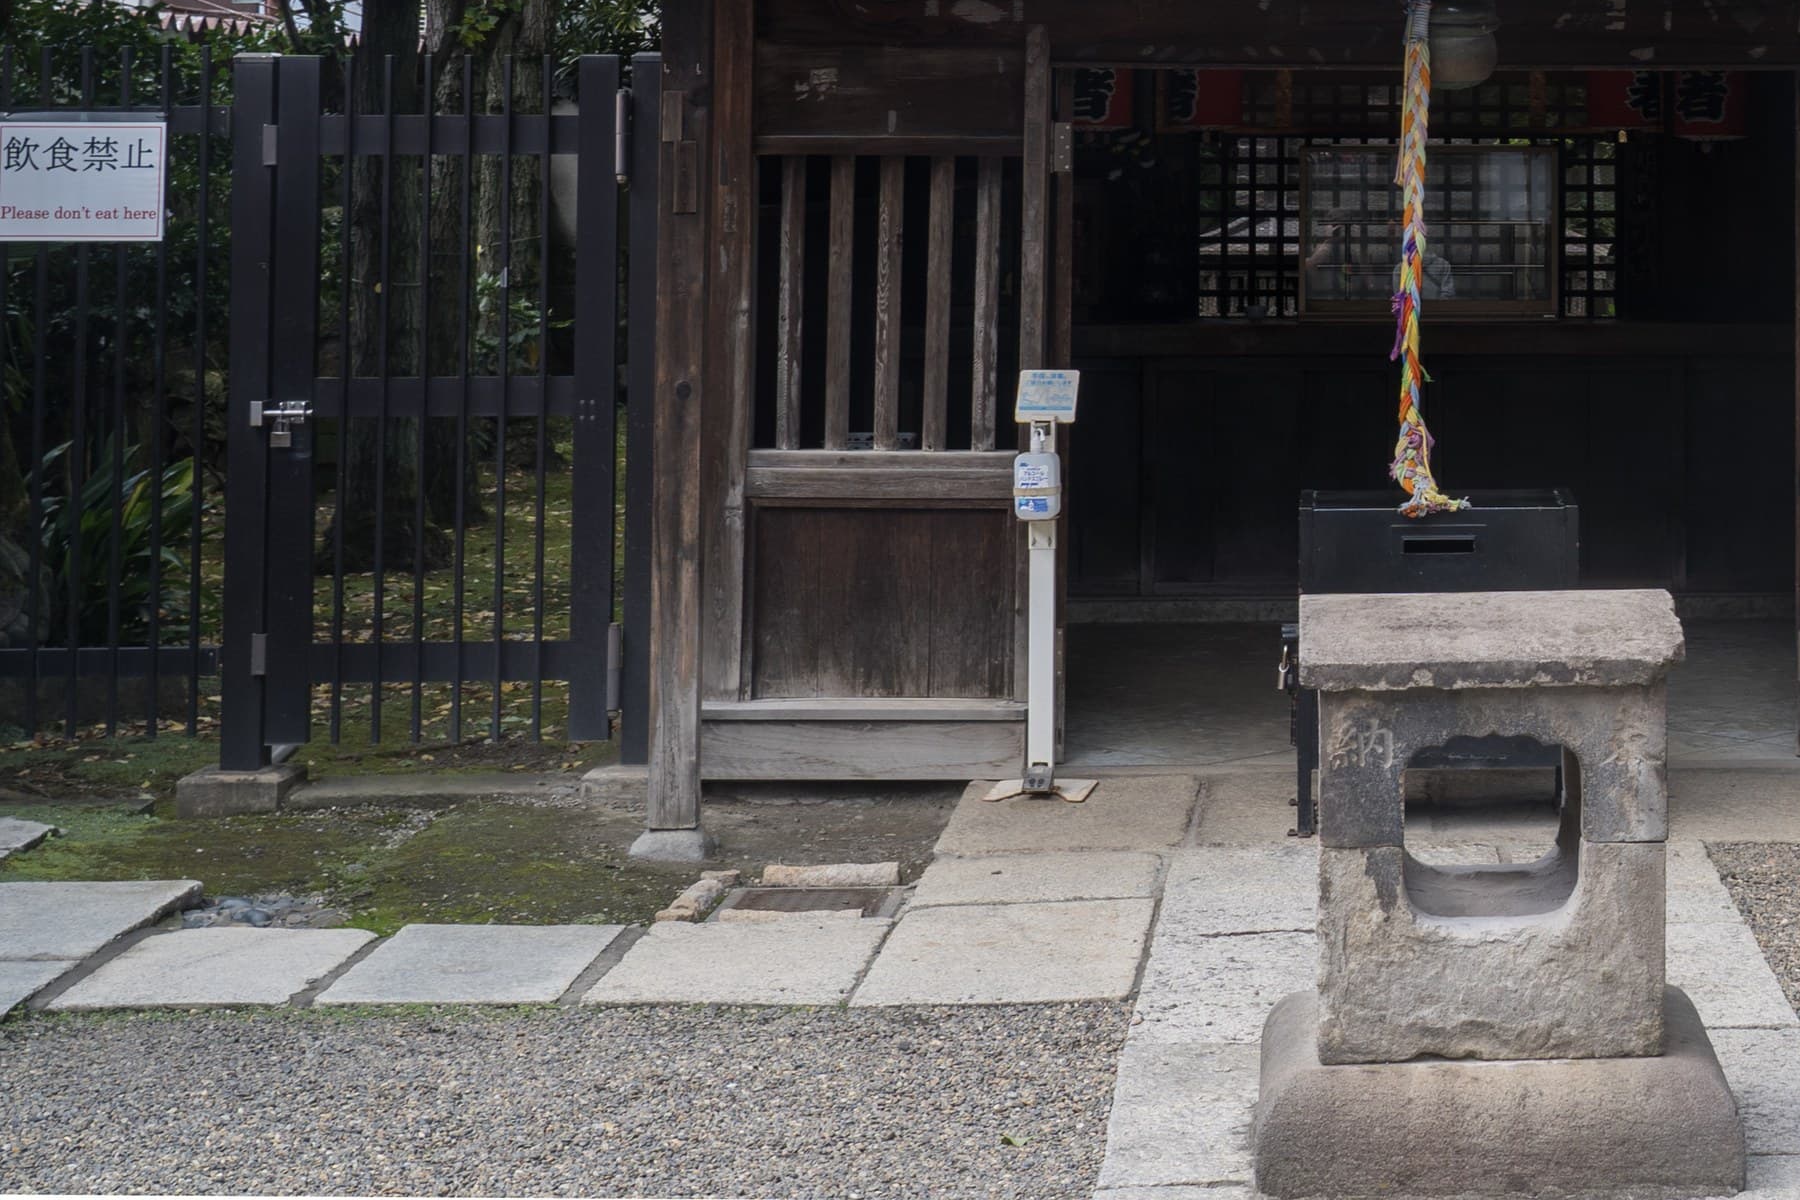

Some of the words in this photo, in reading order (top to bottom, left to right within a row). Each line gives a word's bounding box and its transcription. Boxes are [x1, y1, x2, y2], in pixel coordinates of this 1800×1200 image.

[3, 136, 155, 173] 飲食禁止
[1, 206, 50, 220] Please
[54, 206, 91, 220] don't
[95, 208, 119, 220] eat
[123, 206, 157, 220] here
[1327, 718, 1394, 770] 納
